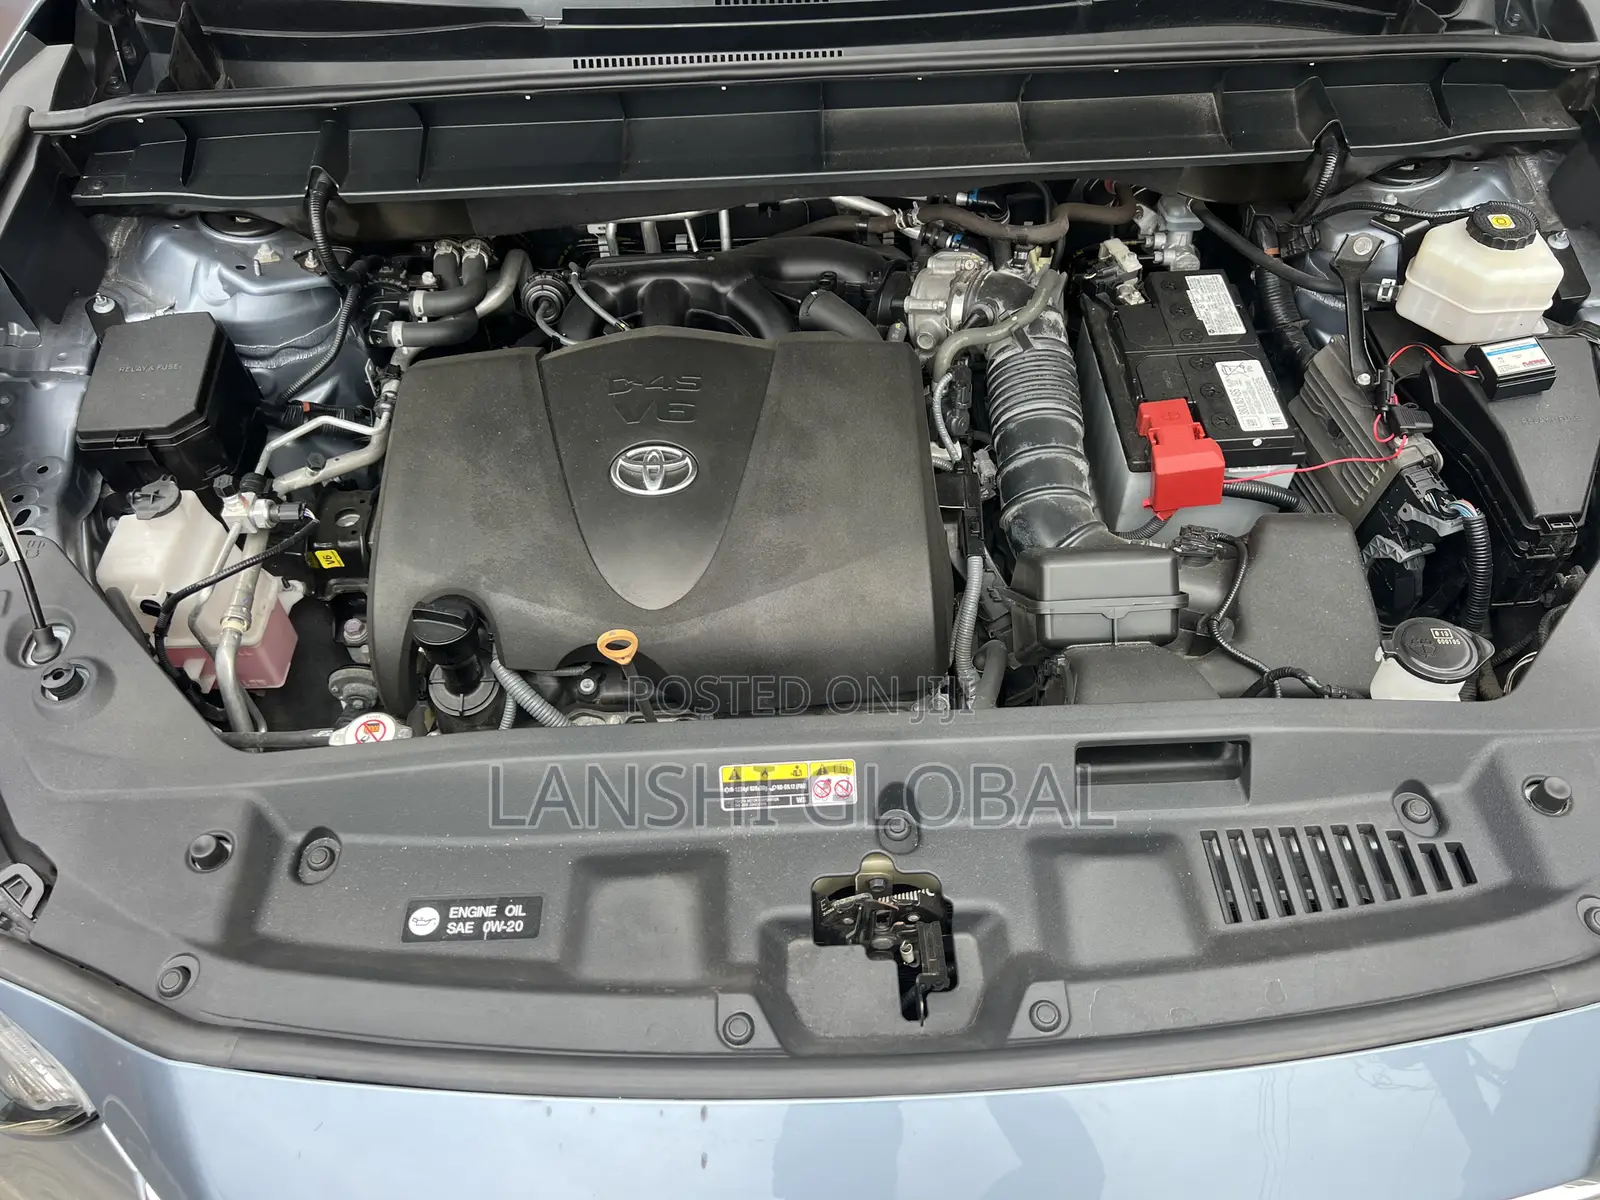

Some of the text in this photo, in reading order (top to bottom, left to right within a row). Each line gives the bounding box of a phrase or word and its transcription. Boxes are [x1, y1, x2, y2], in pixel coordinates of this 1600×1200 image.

[448, 904, 527, 919] ENGINE OIL
[446, 919, 524, 934] SAE 0W-20
